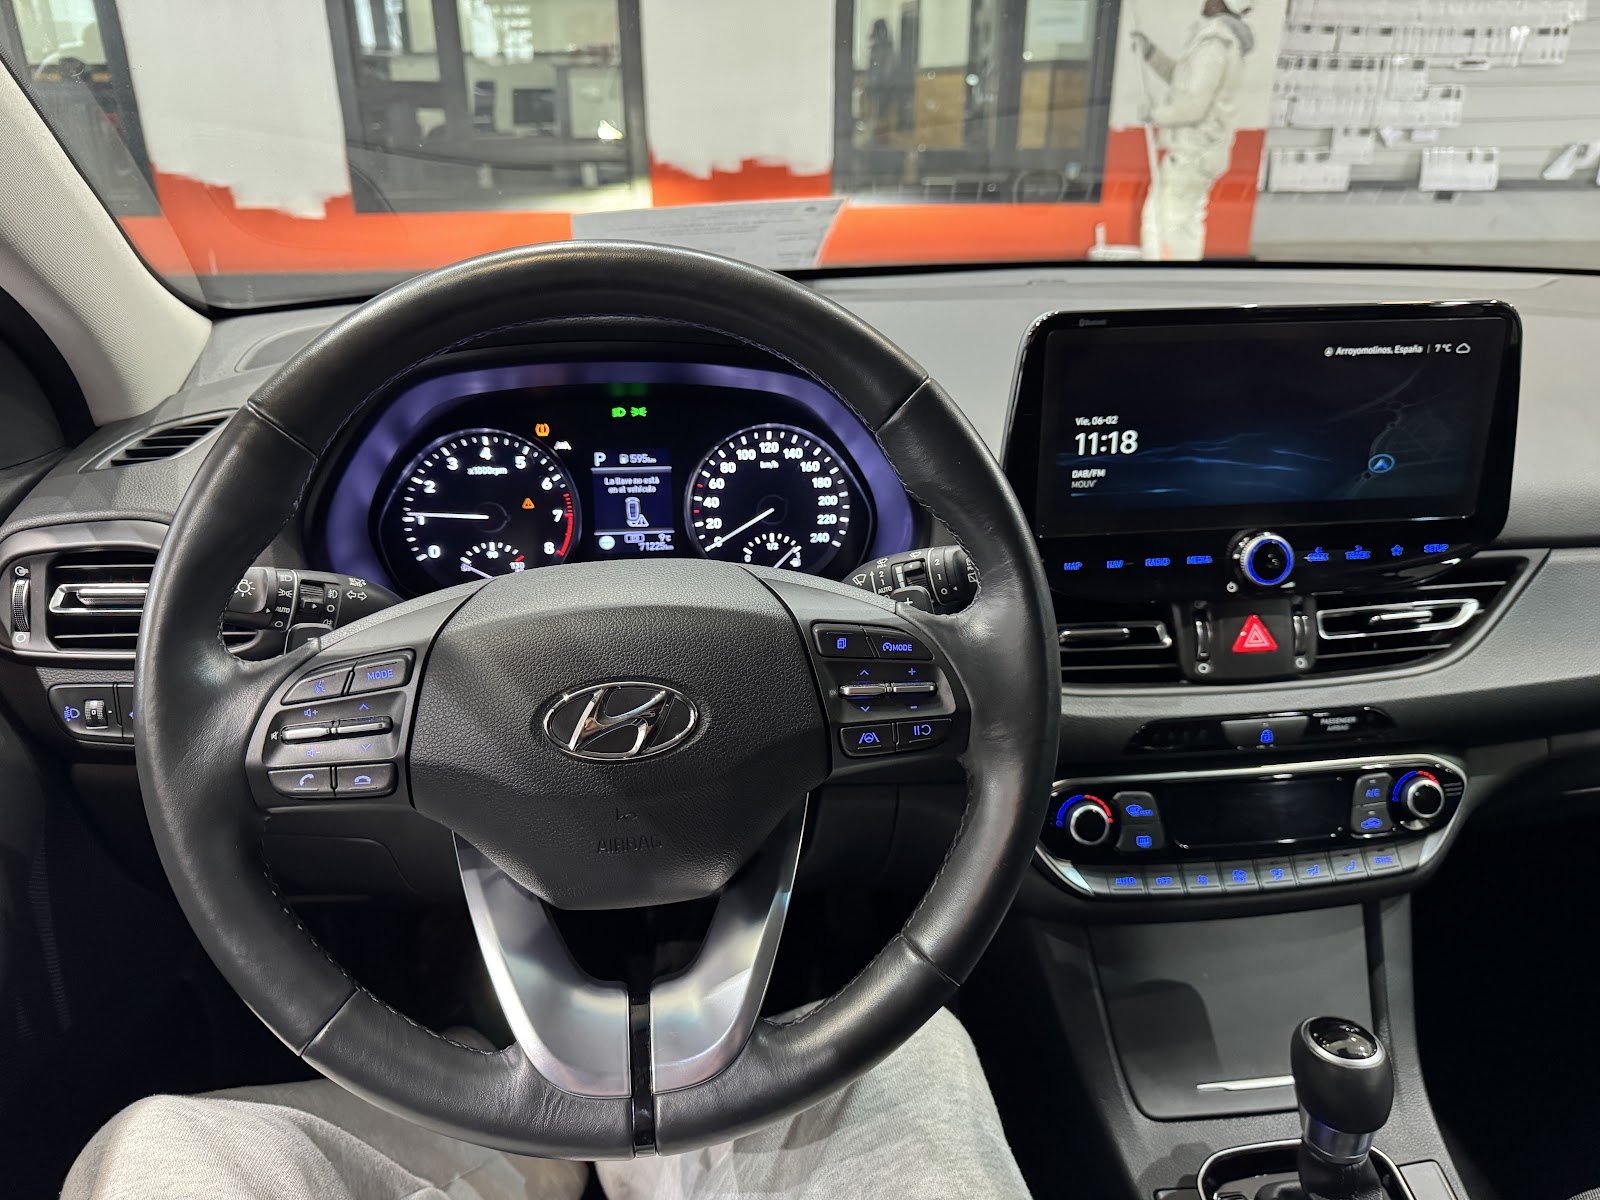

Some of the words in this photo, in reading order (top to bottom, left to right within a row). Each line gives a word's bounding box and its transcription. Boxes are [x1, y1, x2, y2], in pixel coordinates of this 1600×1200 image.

[1394, 344, 1423, 354] España
[1092, 415, 1119, 425] 06-02
[759, 441, 779, 453] 120
[1075, 429, 1138, 456] 11:18
[479, 446, 492, 460] 4
[736, 449, 757, 460] 100
[783, 447, 803, 459] 140
[446, 457, 459, 470] 3
[514, 455, 527, 469] 5
[593, 451, 607, 467] P
[760, 460, 779, 469] km/h
[467, 467, 508, 476] x1000rpm
[719, 462, 737, 473] 80
[800, 461, 820, 472] 160
[1071, 469, 1106, 478] DAB/FM
[423, 480, 436, 494] 2
[541, 477, 553, 490] 6
[708, 478, 725, 489] 60
[812, 476, 832, 488] 180
[703, 497, 720, 508] 40
[818, 495, 838, 506] 200
[552, 509, 563, 522] 7
[817, 514, 837, 525] 220
[705, 518, 722, 529] 20
[810, 532, 830, 543] 240
[427, 545, 441, 559] 0
[543, 541, 555, 555] 8
[1423, 543, 1449, 553] SETUP
[934, 558, 941, 566] 2
[1064, 561, 1083, 571] MAP
[1106, 560, 1125, 569] NAV
[1145, 557, 1171, 567] RADIO
[879, 570, 885, 578] 2
[878, 586, 893, 594] AUTO
[275, 606, 291, 614] AUTO
[892, 644, 912, 652] MODE
[367, 669, 394, 681] MODE
